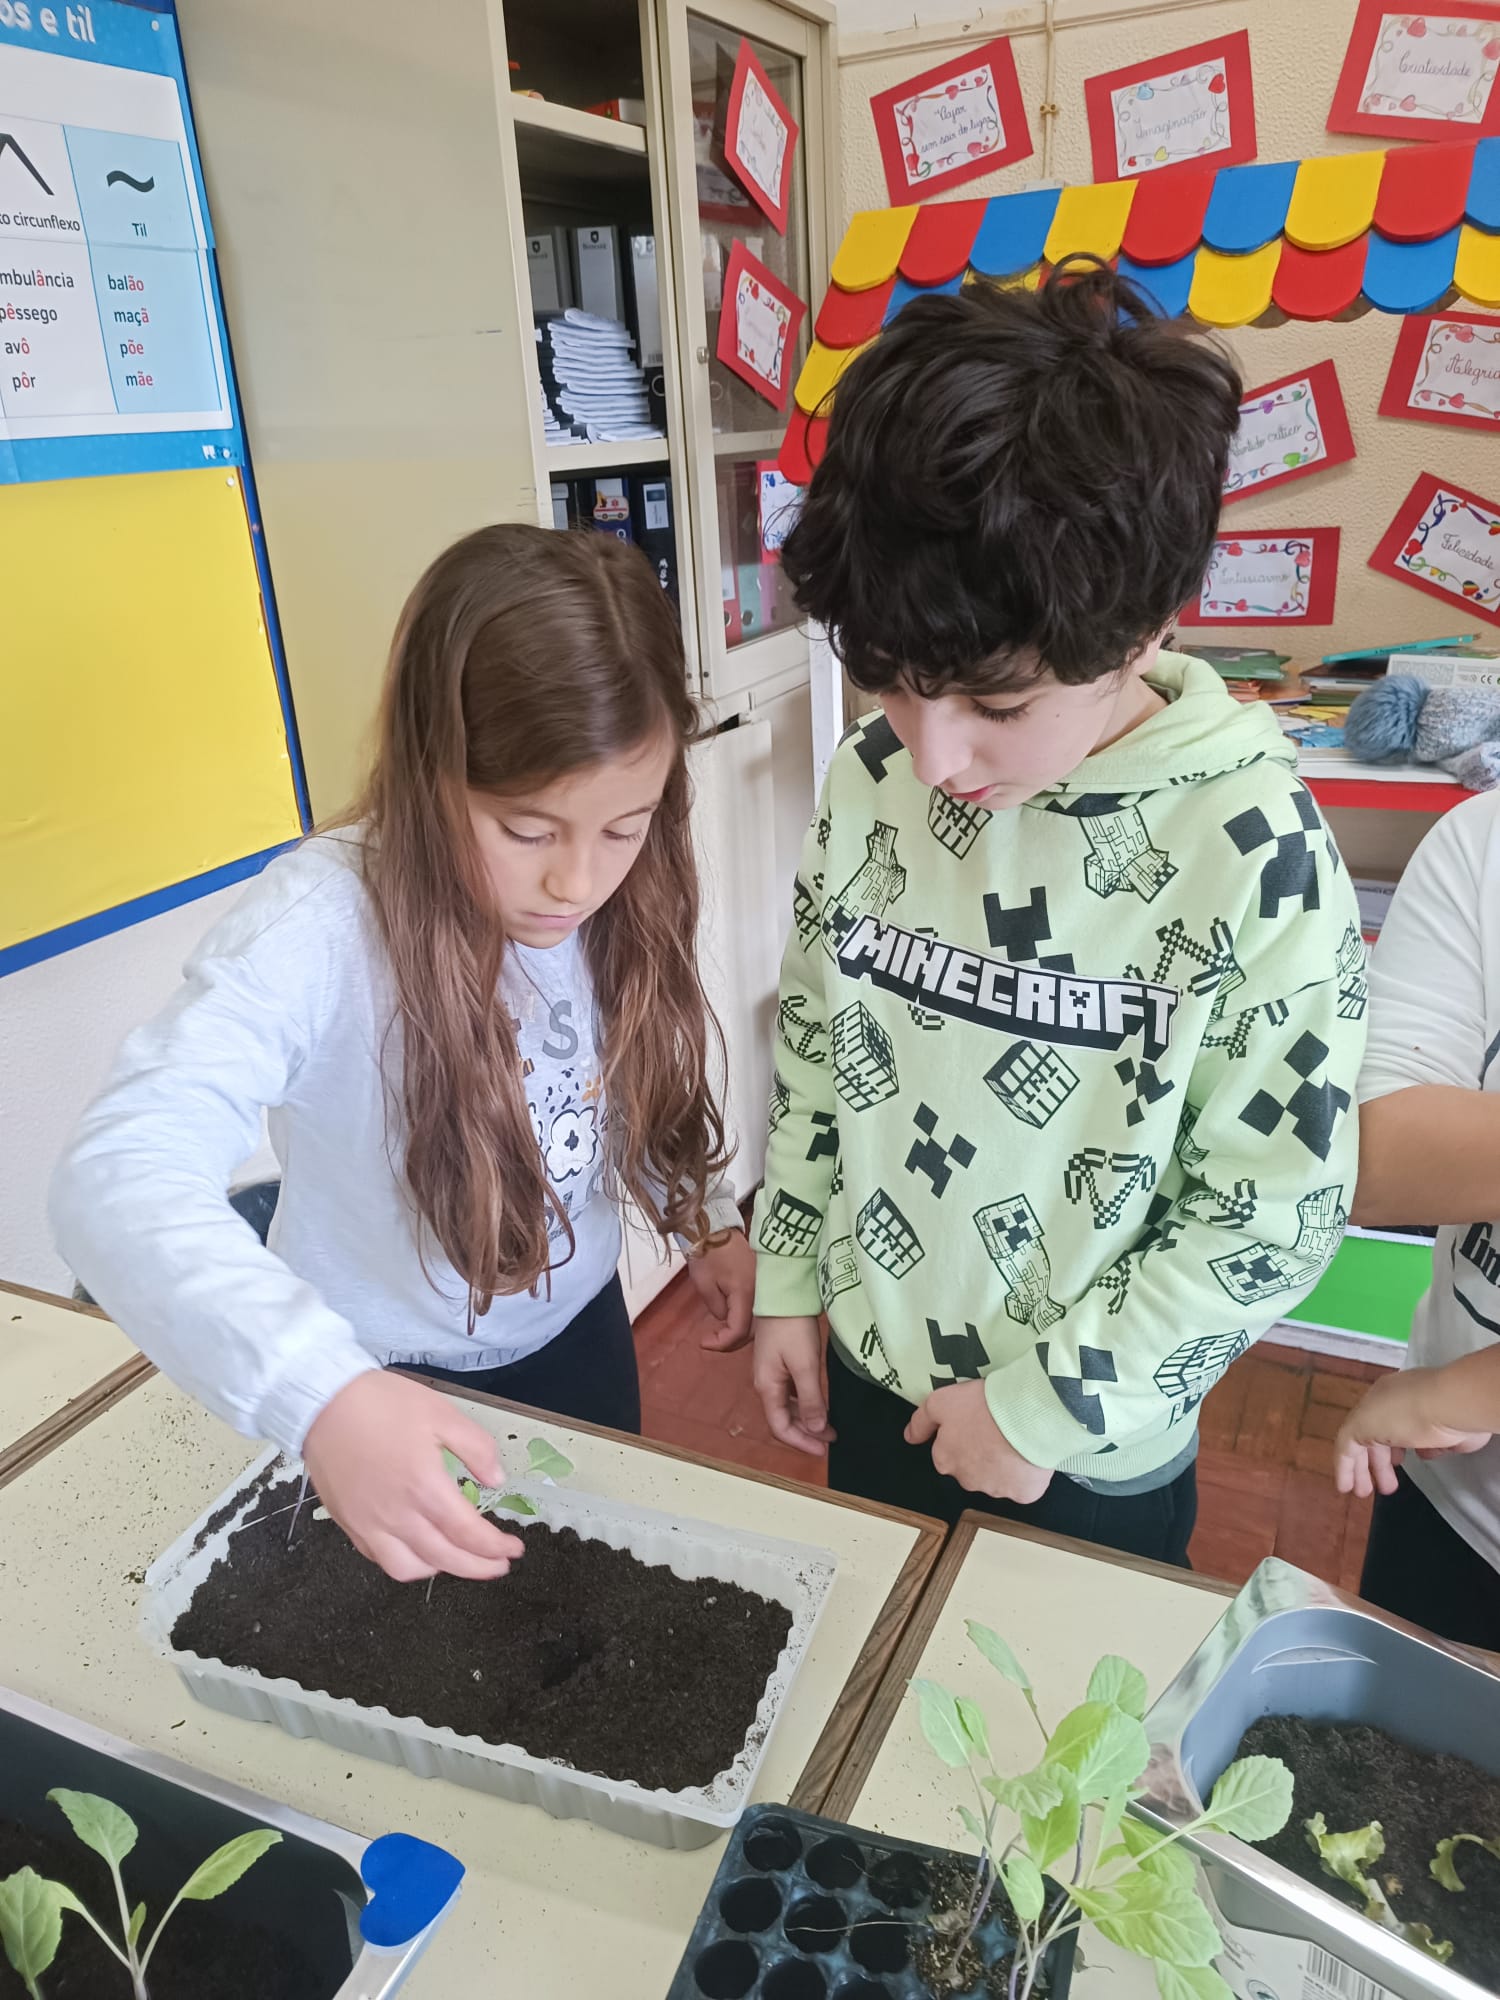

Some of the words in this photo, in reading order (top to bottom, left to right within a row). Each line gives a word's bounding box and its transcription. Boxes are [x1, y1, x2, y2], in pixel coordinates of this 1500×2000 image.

[40, 7, 59, 36] e
[65, 4, 96, 44] til
[13, 211, 81, 232] circunflexo
[131, 223, 148, 237] Til
[107, 274, 145, 292] balão
[114, 307, 150, 327] maçã
[4, 337, 31, 355] avô
[119, 339, 145, 358] põe
[12, 371, 36, 393] pôr
[125, 371, 154, 387] mãe
[1440, 533, 1495, 571] Felicidade
[837, 914, 1181, 1062] MINECRAFT
